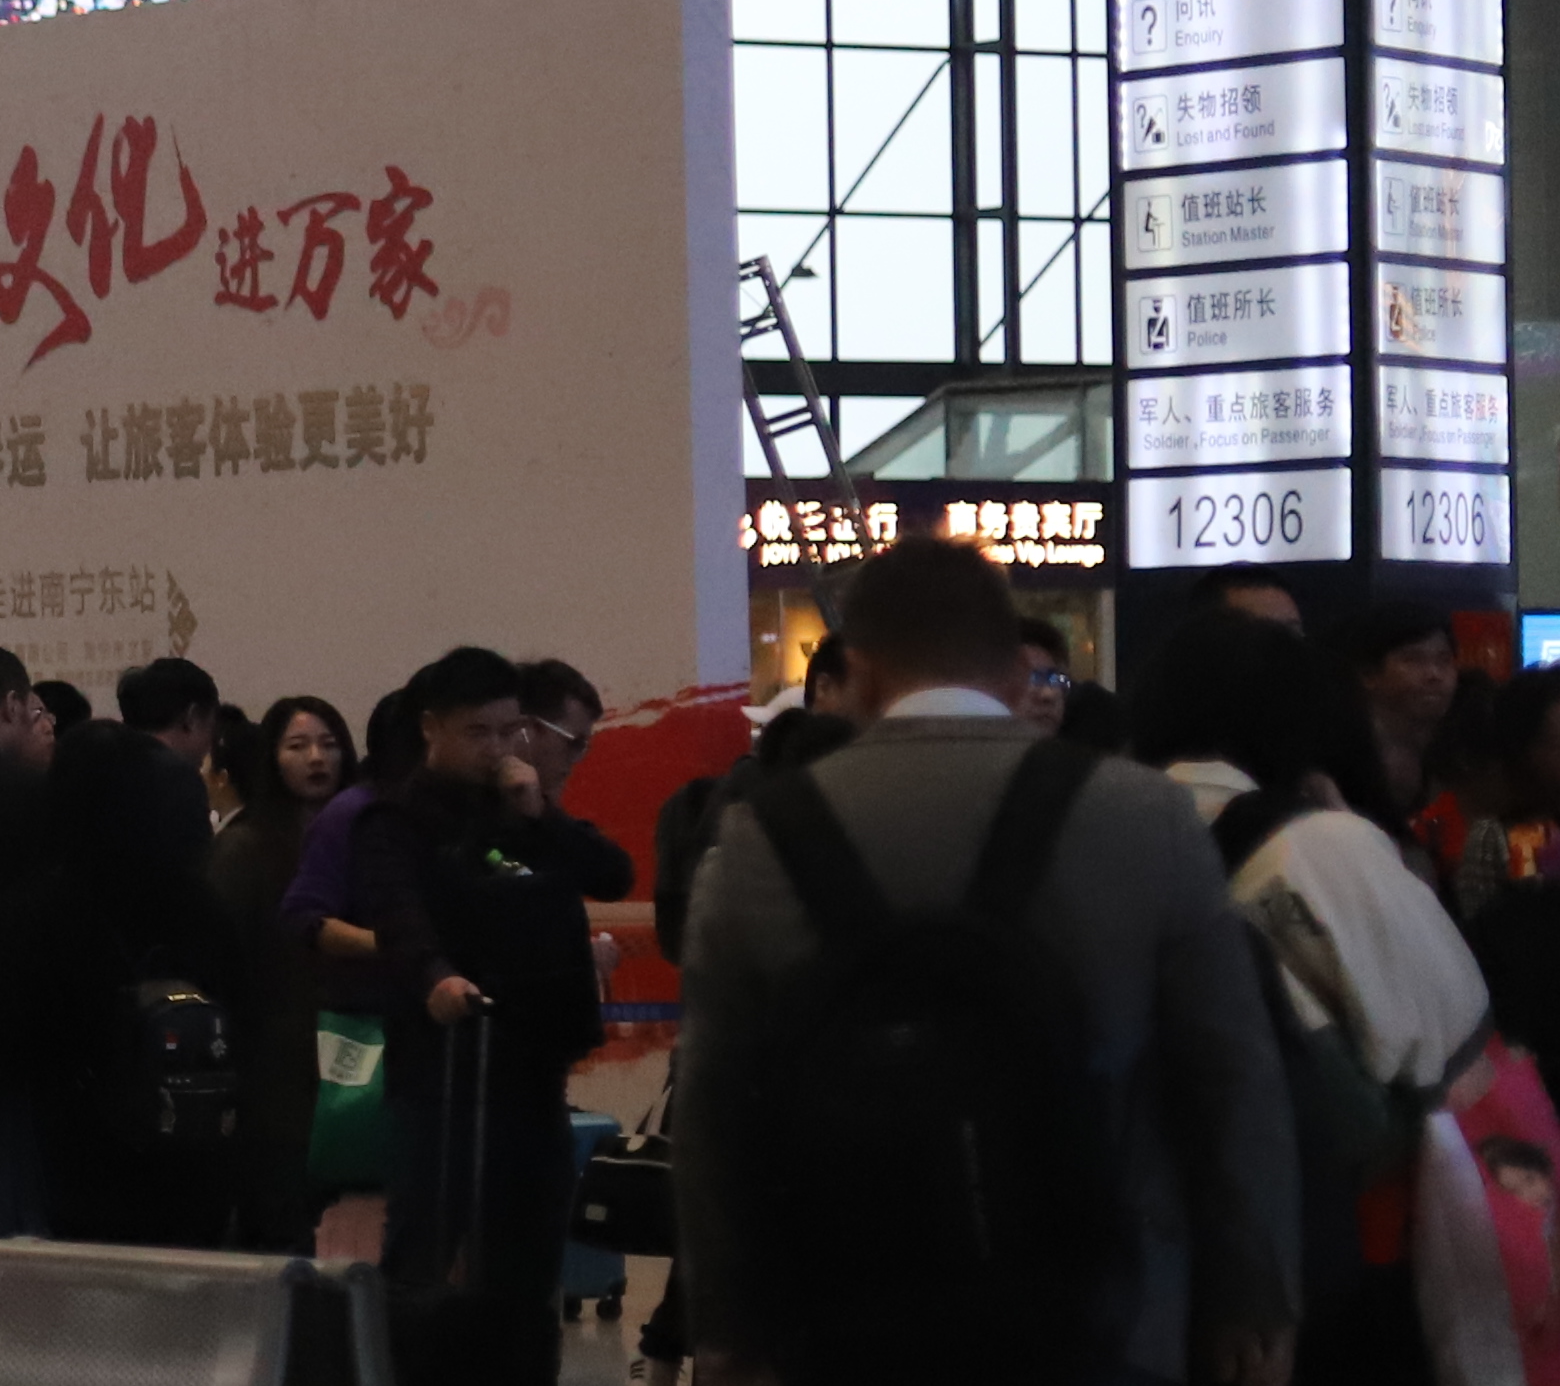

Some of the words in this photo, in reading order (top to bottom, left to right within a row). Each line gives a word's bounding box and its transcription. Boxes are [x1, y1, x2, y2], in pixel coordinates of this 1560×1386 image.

[1175, 28, 1224, 47] Enquiry
[1177, 84, 1262, 123] 失物招领
[1176, 128, 1204, 148] Lost
[1207, 126, 1231, 143] and
[1234, 121, 1275, 140] Found
[1182, 186, 1267, 224] 值班站长
[1182, 228, 1228, 248] Station
[1230, 224, 1276, 242] Master
[1187, 287, 1276, 325] 值班所长
[1187, 330, 1227, 348] Police
[1139, 387, 1335, 426] 军人、重点旅客服务
[81, 382, 436, 485] 让旅客体验更美好
[1144, 433, 1190, 451] Soldier
[1242, 432, 1258, 446] on
[1261, 427, 1330, 447] Passenger
[1169, 490, 1304, 549] 12306
[1407, 490, 1485, 546] 12306
